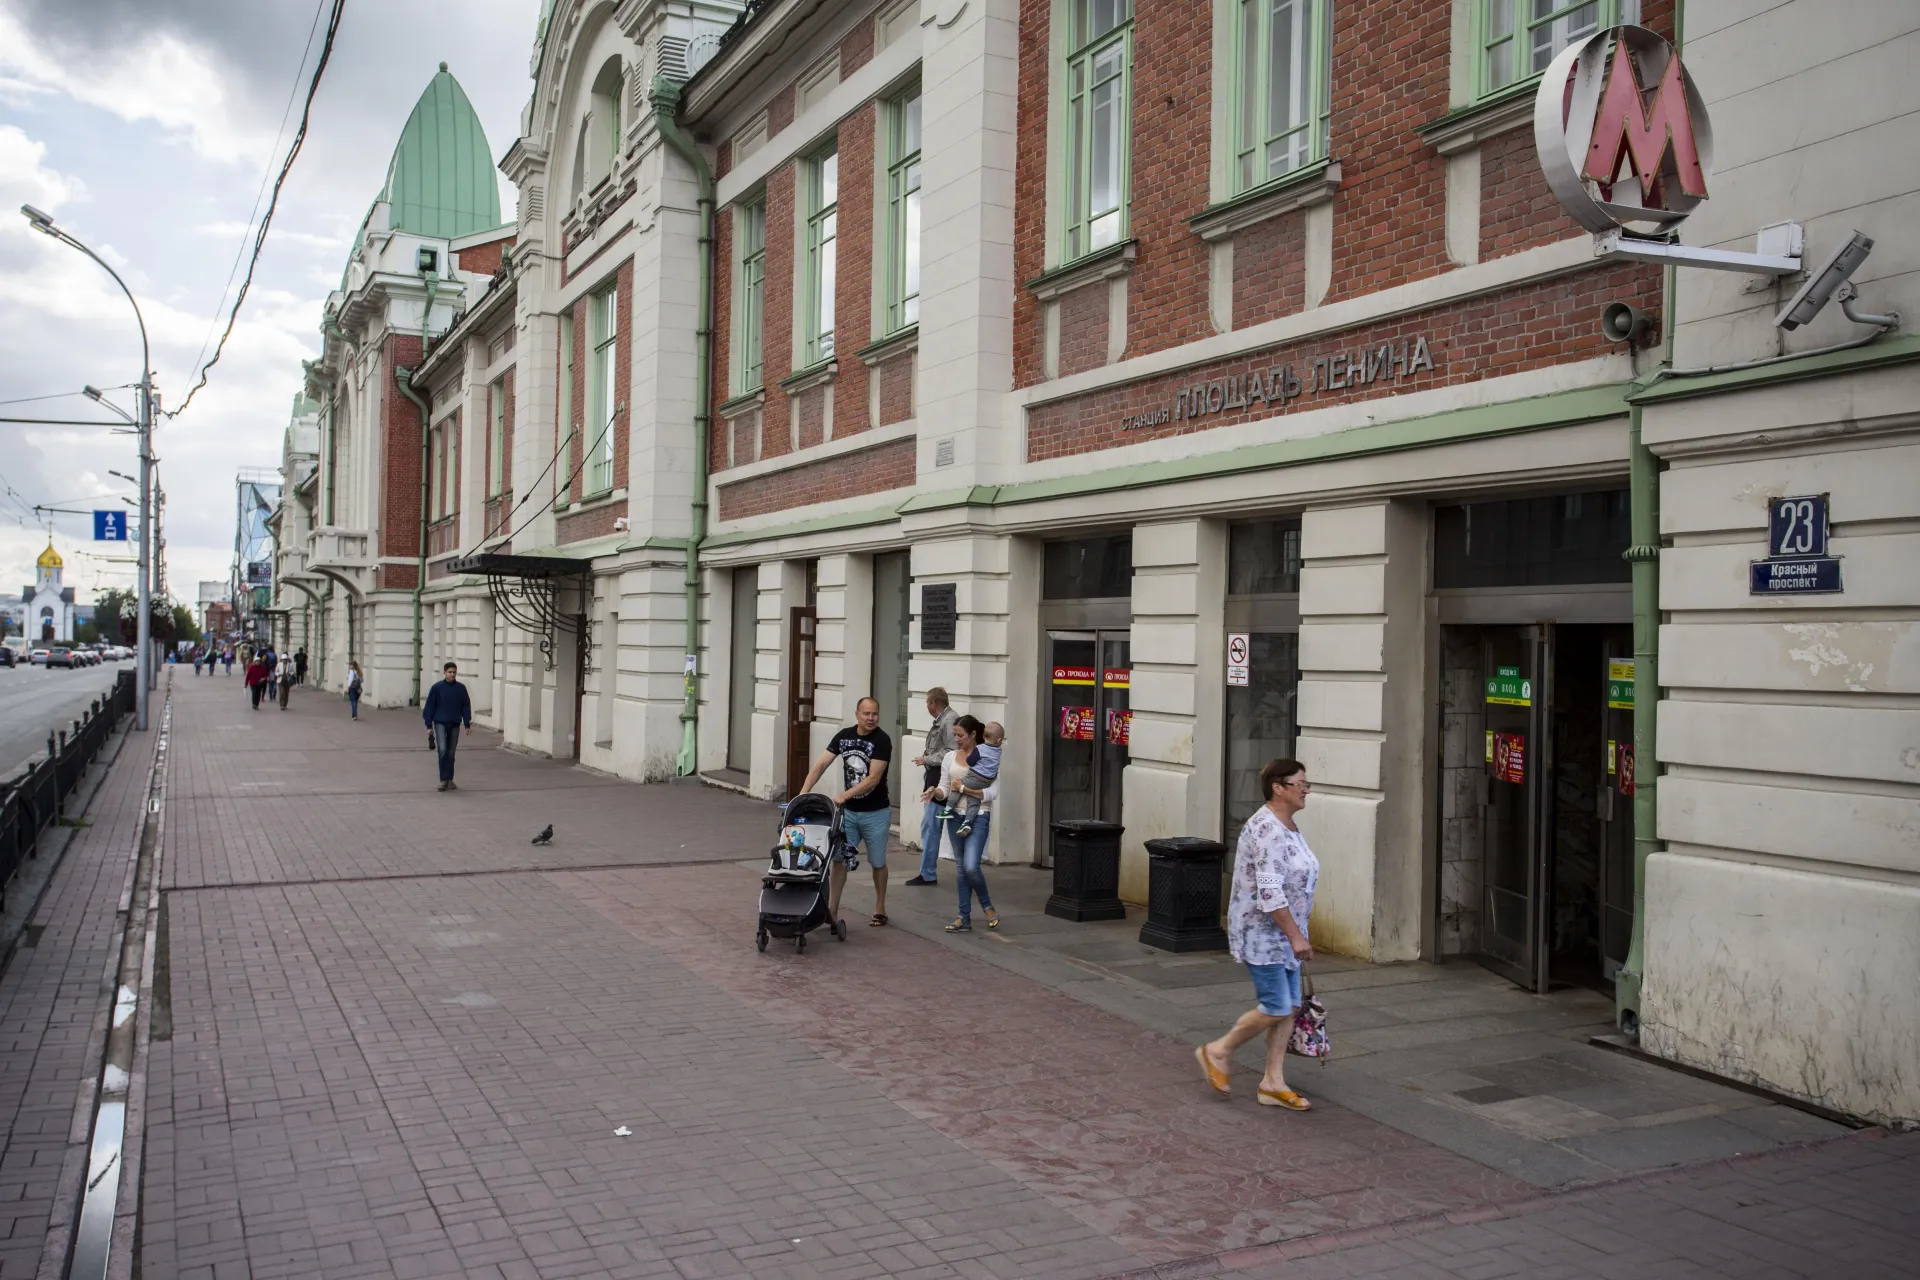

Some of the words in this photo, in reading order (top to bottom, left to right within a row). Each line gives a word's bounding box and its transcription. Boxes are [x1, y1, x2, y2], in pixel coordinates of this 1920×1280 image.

[1120, 408, 1170, 431] СТАНЦИЯ
[1174, 365, 1303, 421] ПЛОЩАДЬ
[1308, 336, 1435, 393] ЛЕНИНА
[1779, 500, 1814, 554] 23
[1771, 563, 1818, 577] Красный
[1768, 577, 1818, 590] проспект
[1068, 670, 1089, 678] ПРОХОДА
[1502, 684, 1516, 693] ВХОД
[1625, 687, 1634, 696] ВХО
